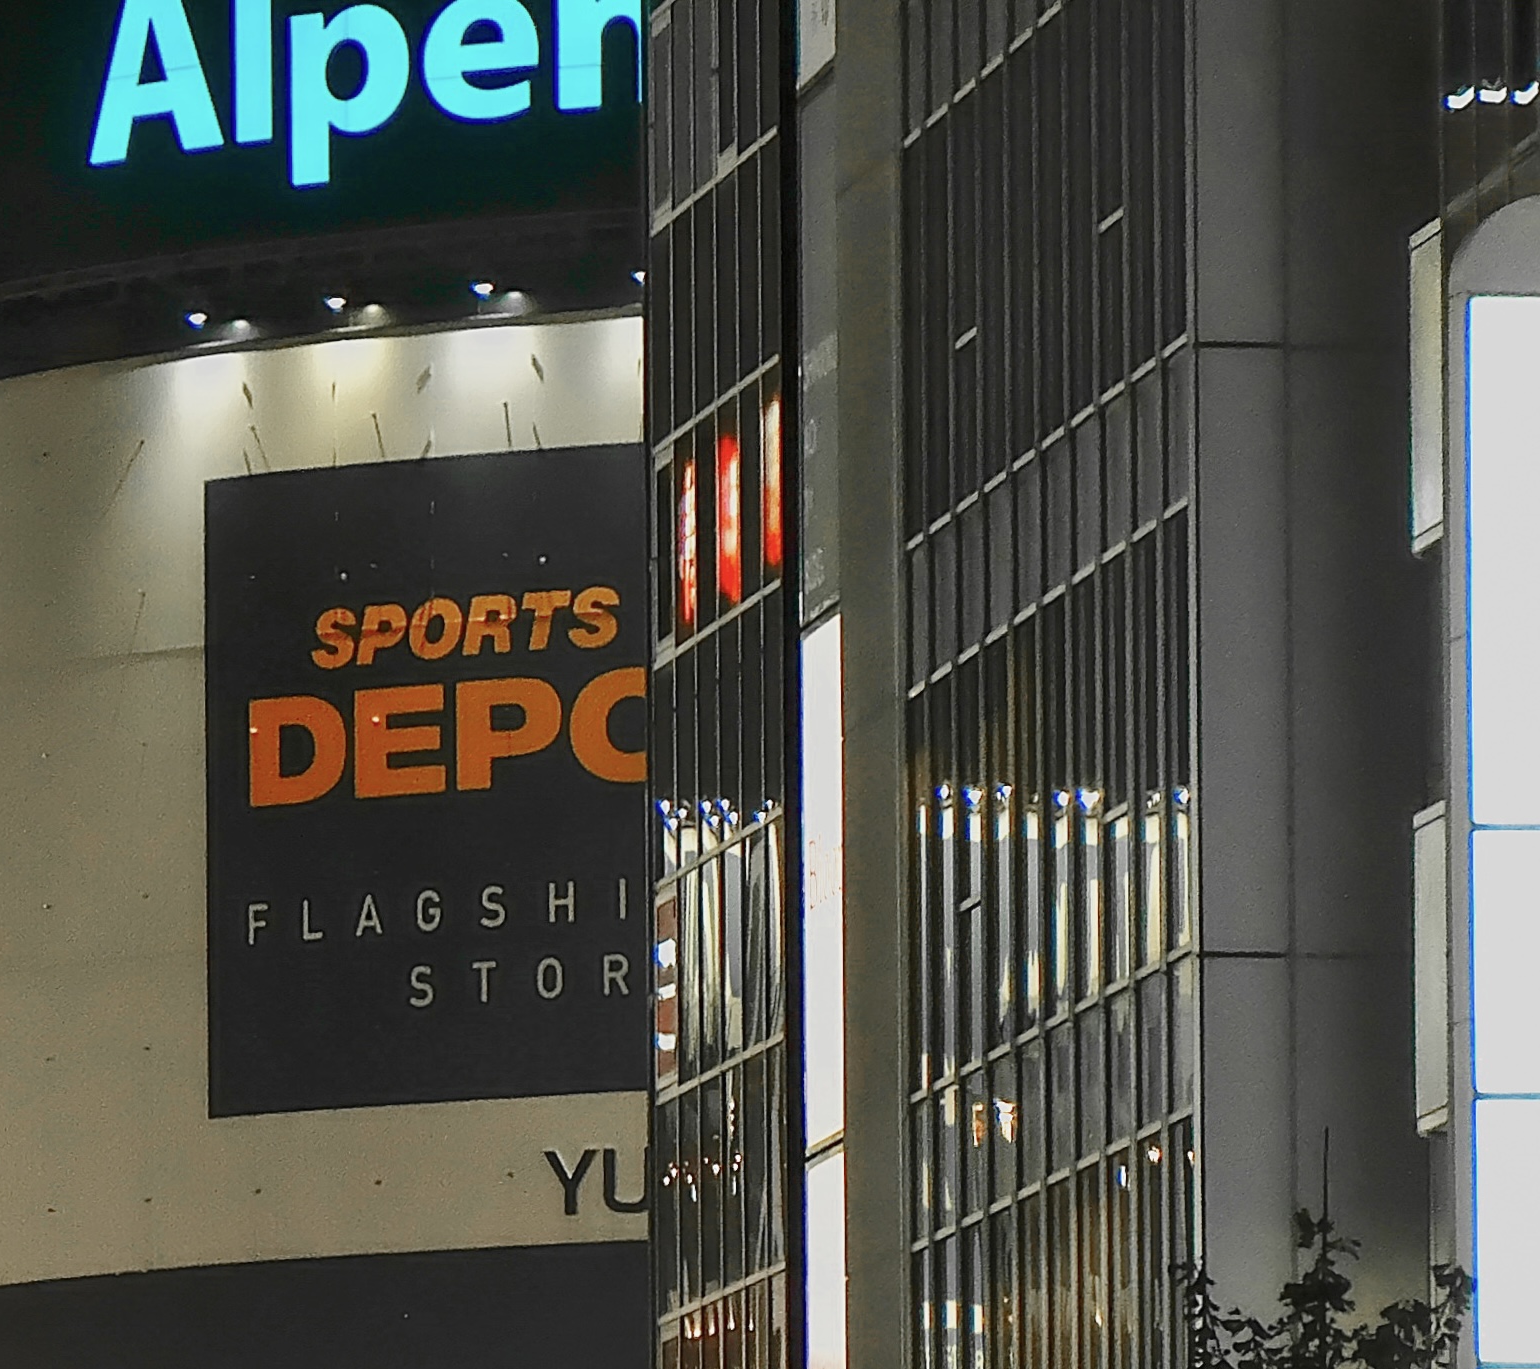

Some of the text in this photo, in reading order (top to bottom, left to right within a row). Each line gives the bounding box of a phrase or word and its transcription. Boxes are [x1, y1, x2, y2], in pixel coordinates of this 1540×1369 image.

[89, 0, 644, 189] Alpen
[310, 585, 621, 671] SPORTS
[248, 876, 630, 946] FLAGSHI
[409, 954, 631, 1008] STOR
